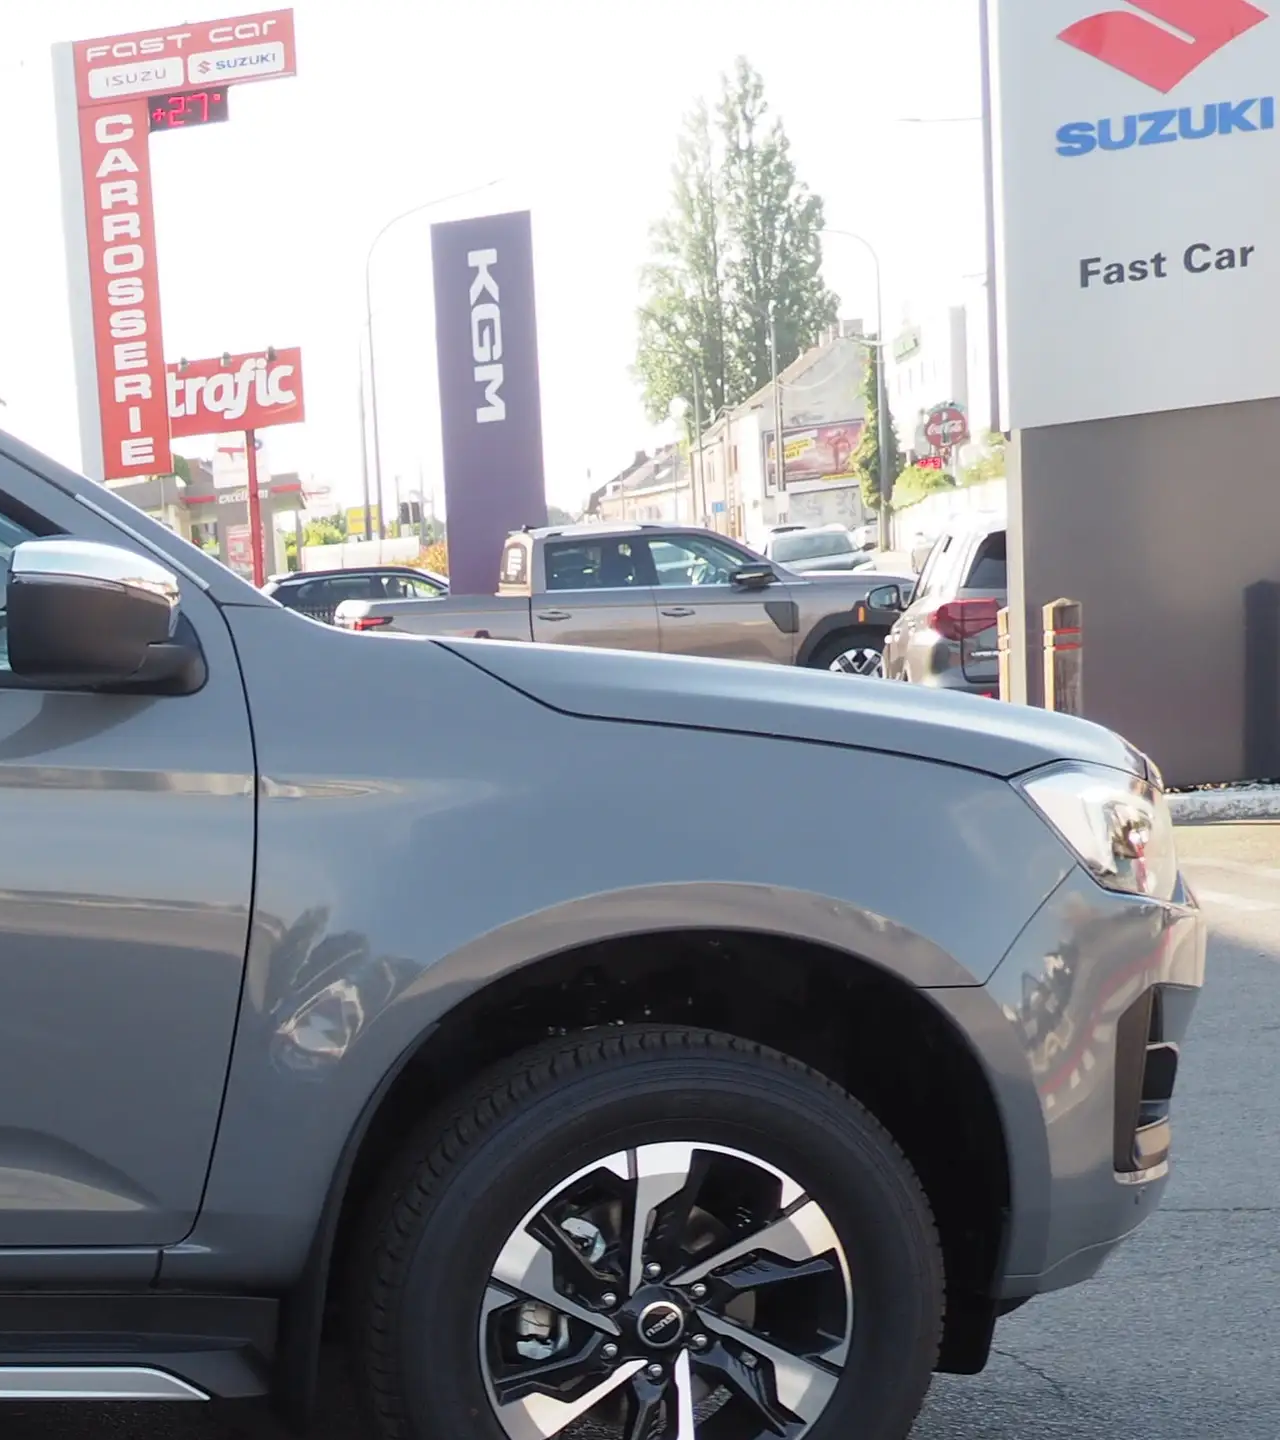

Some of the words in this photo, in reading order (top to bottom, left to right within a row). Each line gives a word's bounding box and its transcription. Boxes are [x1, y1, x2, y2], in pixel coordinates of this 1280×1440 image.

[105, 68, 167, 88] ISUZU
[215, 52, 276, 70] SUZUKI
[1055, 96, 1275, 157] SUZUKI
[95, 114, 156, 467] CARROSSERIE
[1079, 252, 1167, 288] Fast
[1183, 242, 1255, 275] Car
[467, 248, 506, 424] KGM
[167, 358, 297, 420] trafic
[645, 1311, 678, 1337] ISUZU
